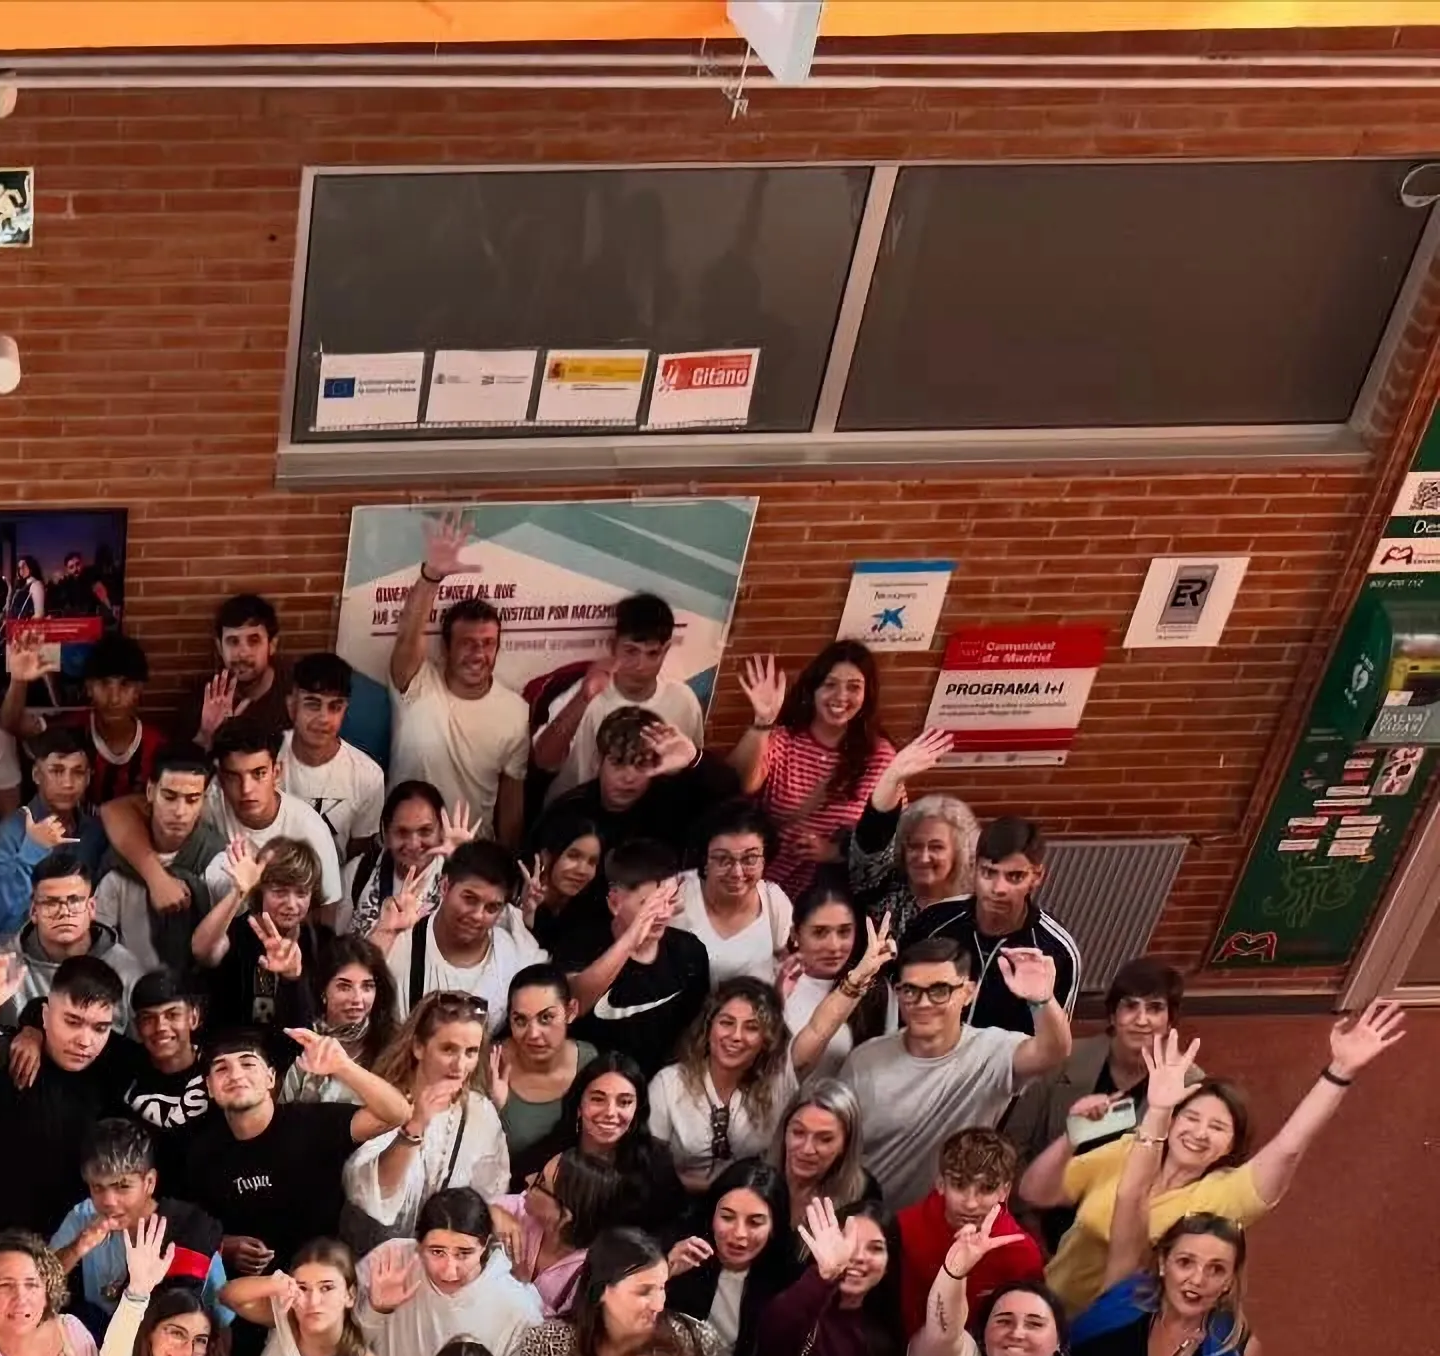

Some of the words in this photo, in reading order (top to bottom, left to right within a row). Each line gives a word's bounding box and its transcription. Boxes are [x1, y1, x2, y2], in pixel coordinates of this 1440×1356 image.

[691, 366, 749, 387] Gitano
[986, 640, 1056, 651] Comunidad
[981, 652, 1000, 663] de
[1002, 652, 1052, 663] Madrid
[945, 682, 1040, 696] PROGRAMA
